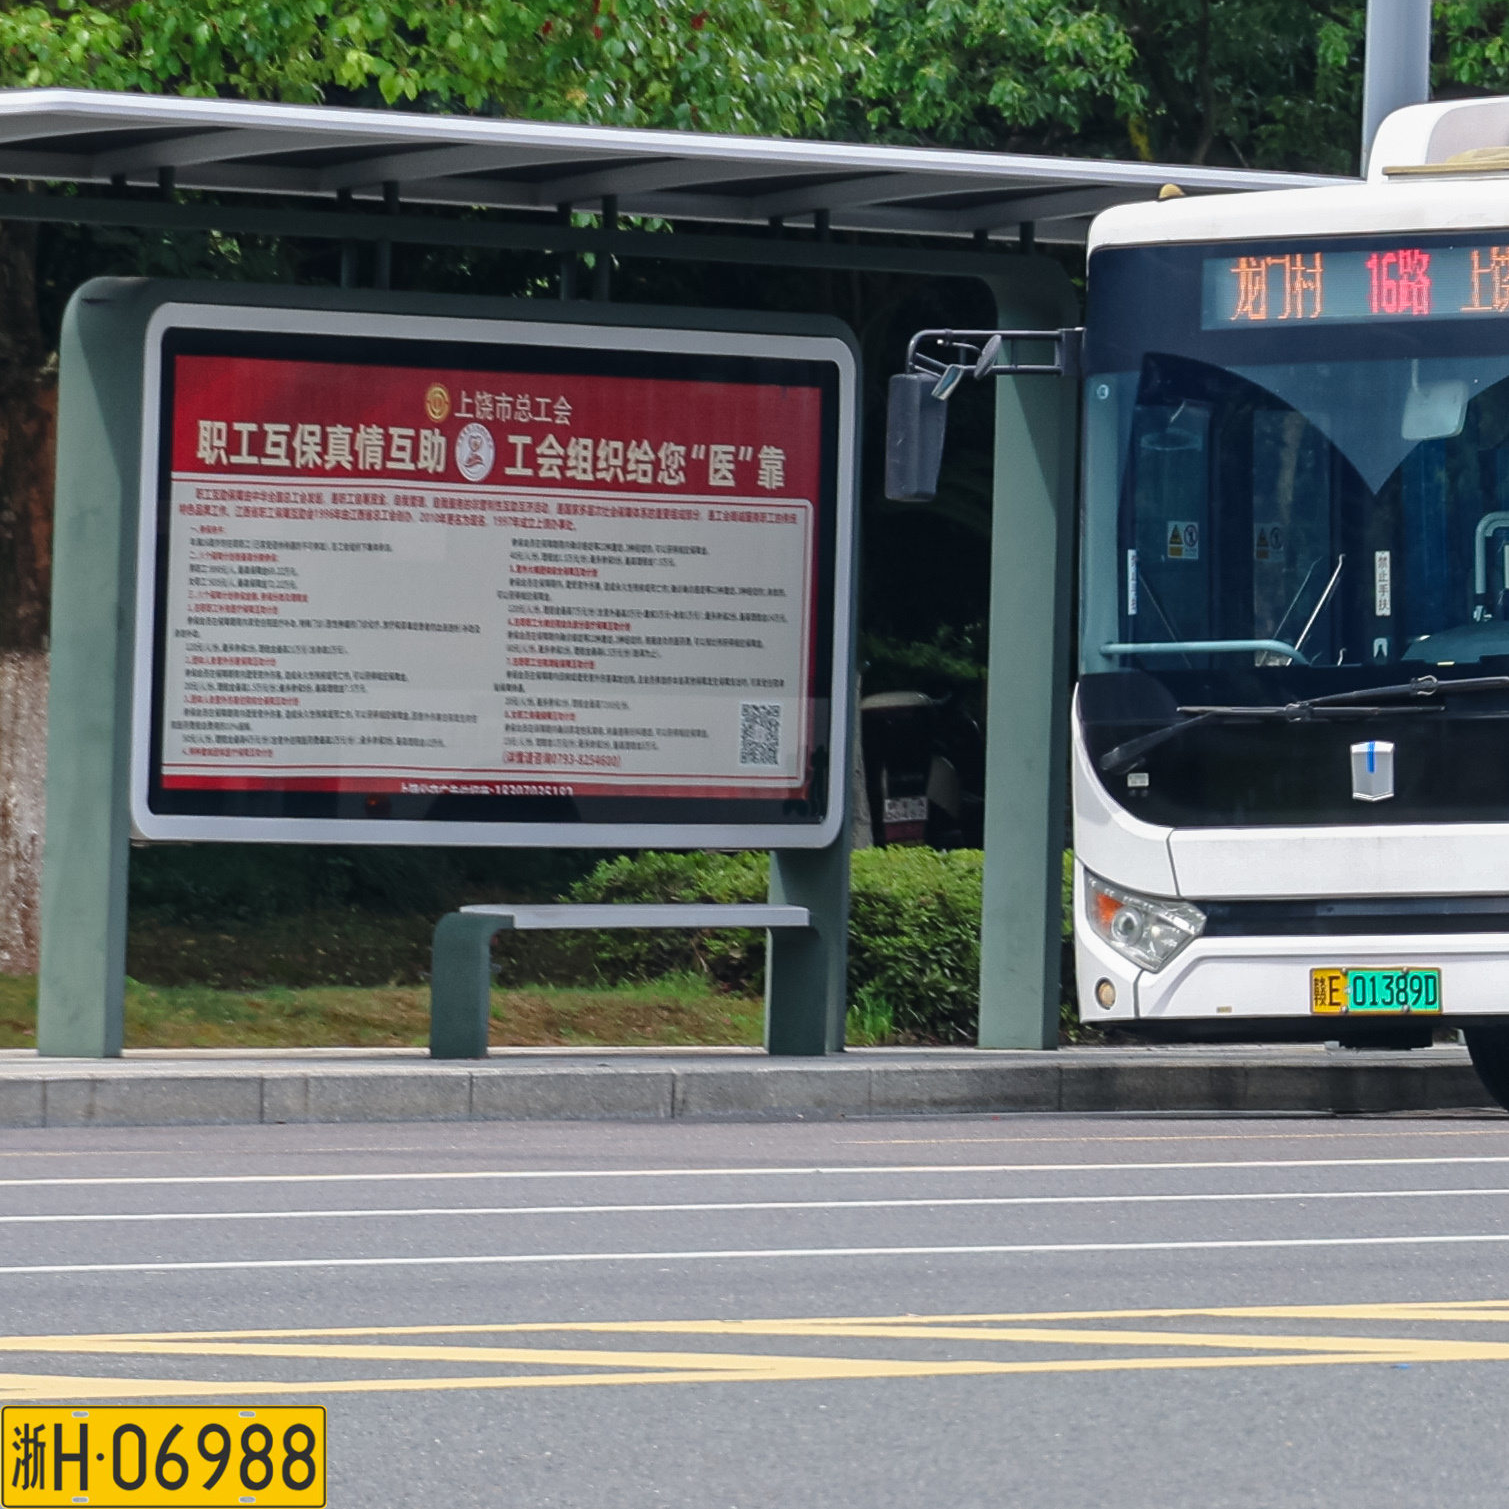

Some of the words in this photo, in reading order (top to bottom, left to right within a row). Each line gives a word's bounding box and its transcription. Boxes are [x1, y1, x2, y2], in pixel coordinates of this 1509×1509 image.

[1229, 251, 1324, 320] 龙门村
[1366, 248, 1434, 316] 16路
[454, 390, 573, 426] 上饶市总工会
[196, 409, 447, 474] 职工互保真情互助
